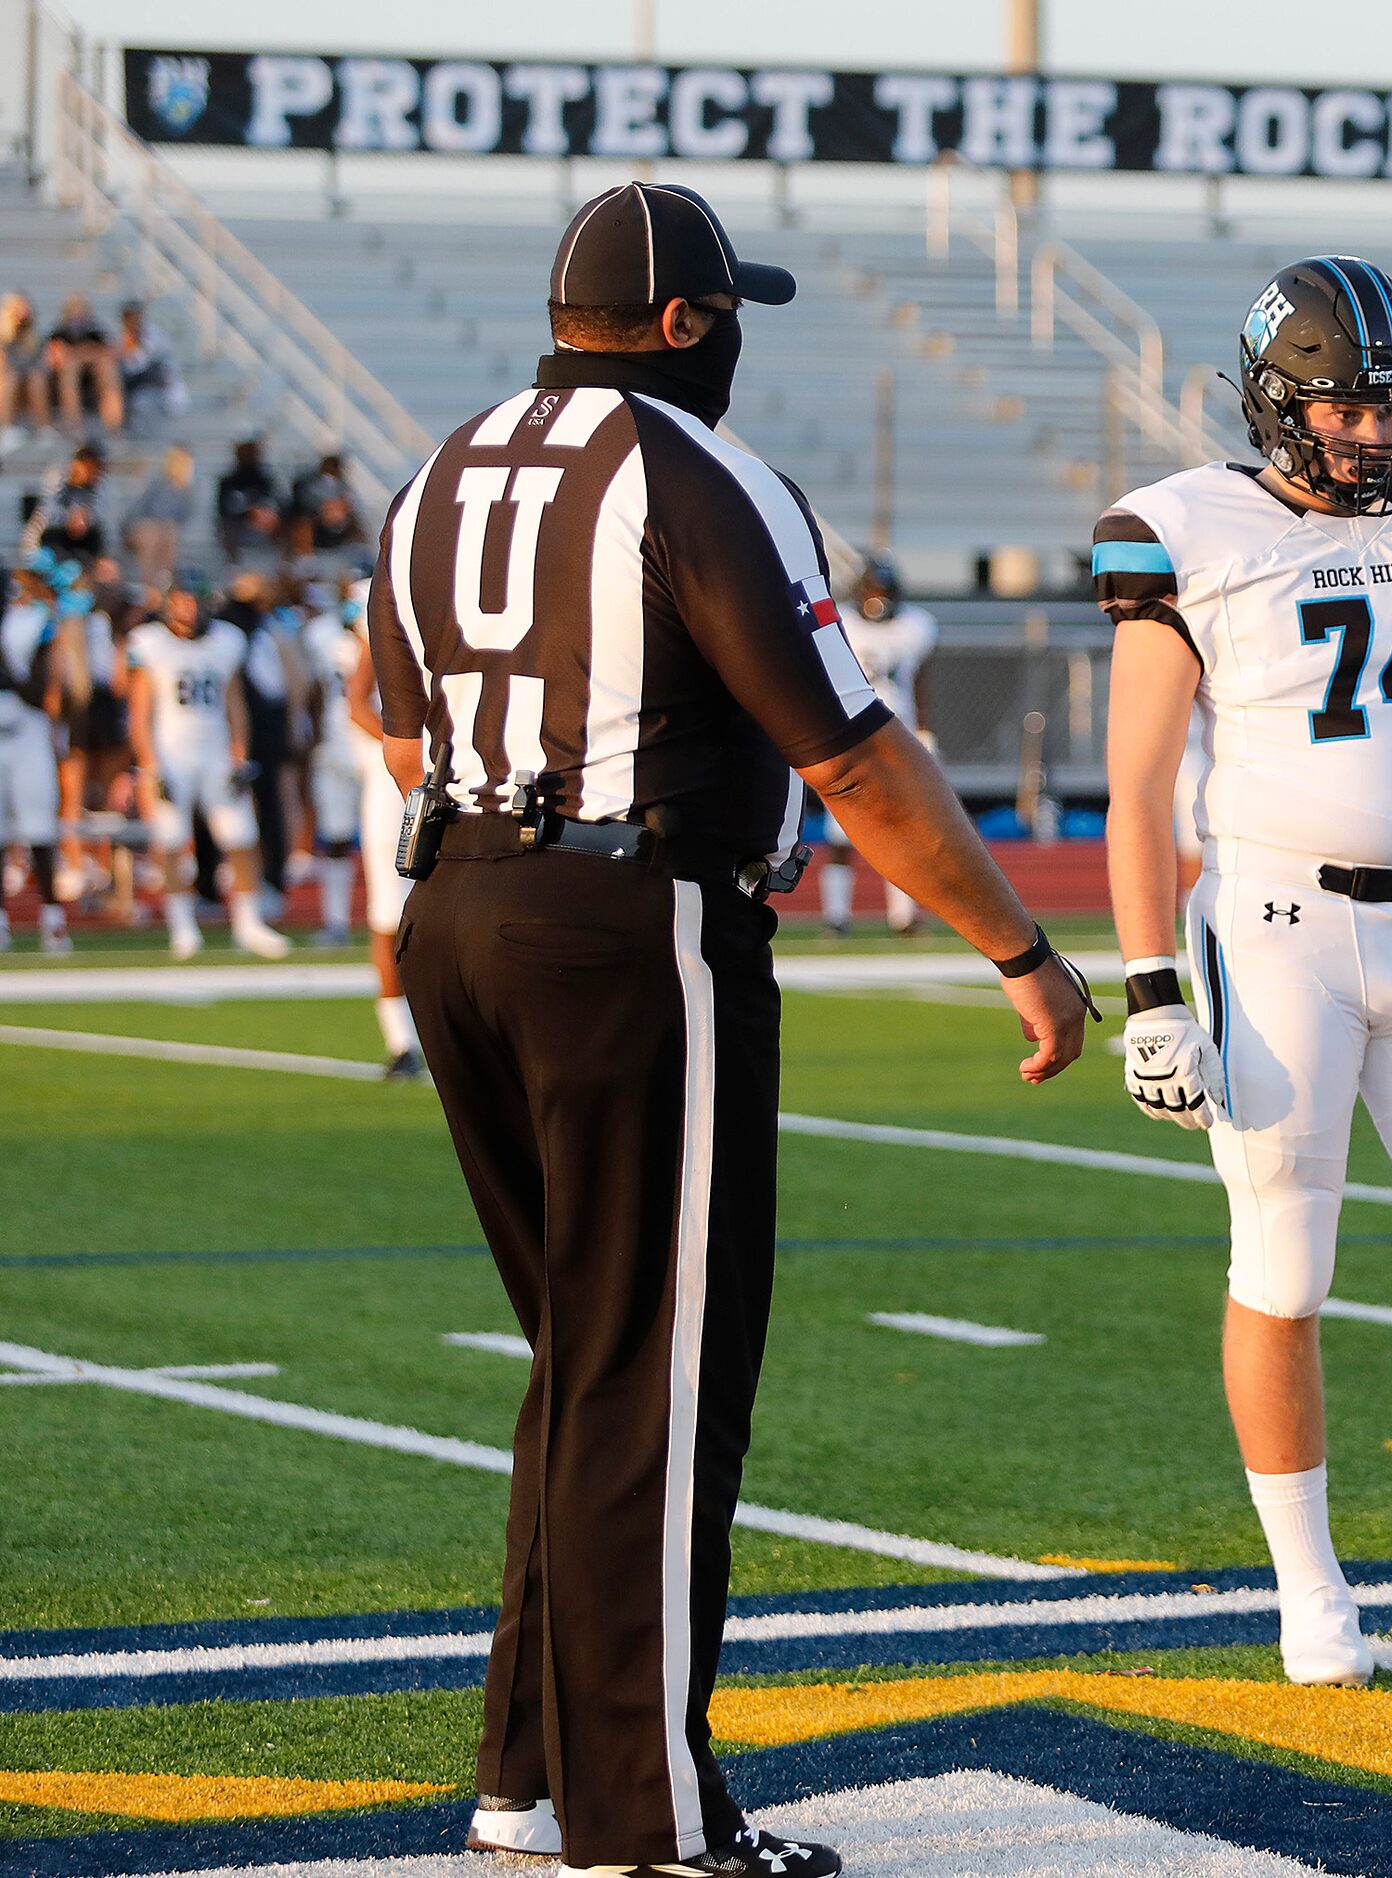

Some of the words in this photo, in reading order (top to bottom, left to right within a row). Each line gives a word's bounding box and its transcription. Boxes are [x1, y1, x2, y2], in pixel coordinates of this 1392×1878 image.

[244, 54, 834, 160] PROTECT
[873, 73, 1117, 169] THE
[455, 466, 566, 652] U
[1312, 567, 1365, 589] ROCK
[1130, 1034, 1173, 1046] adidas
